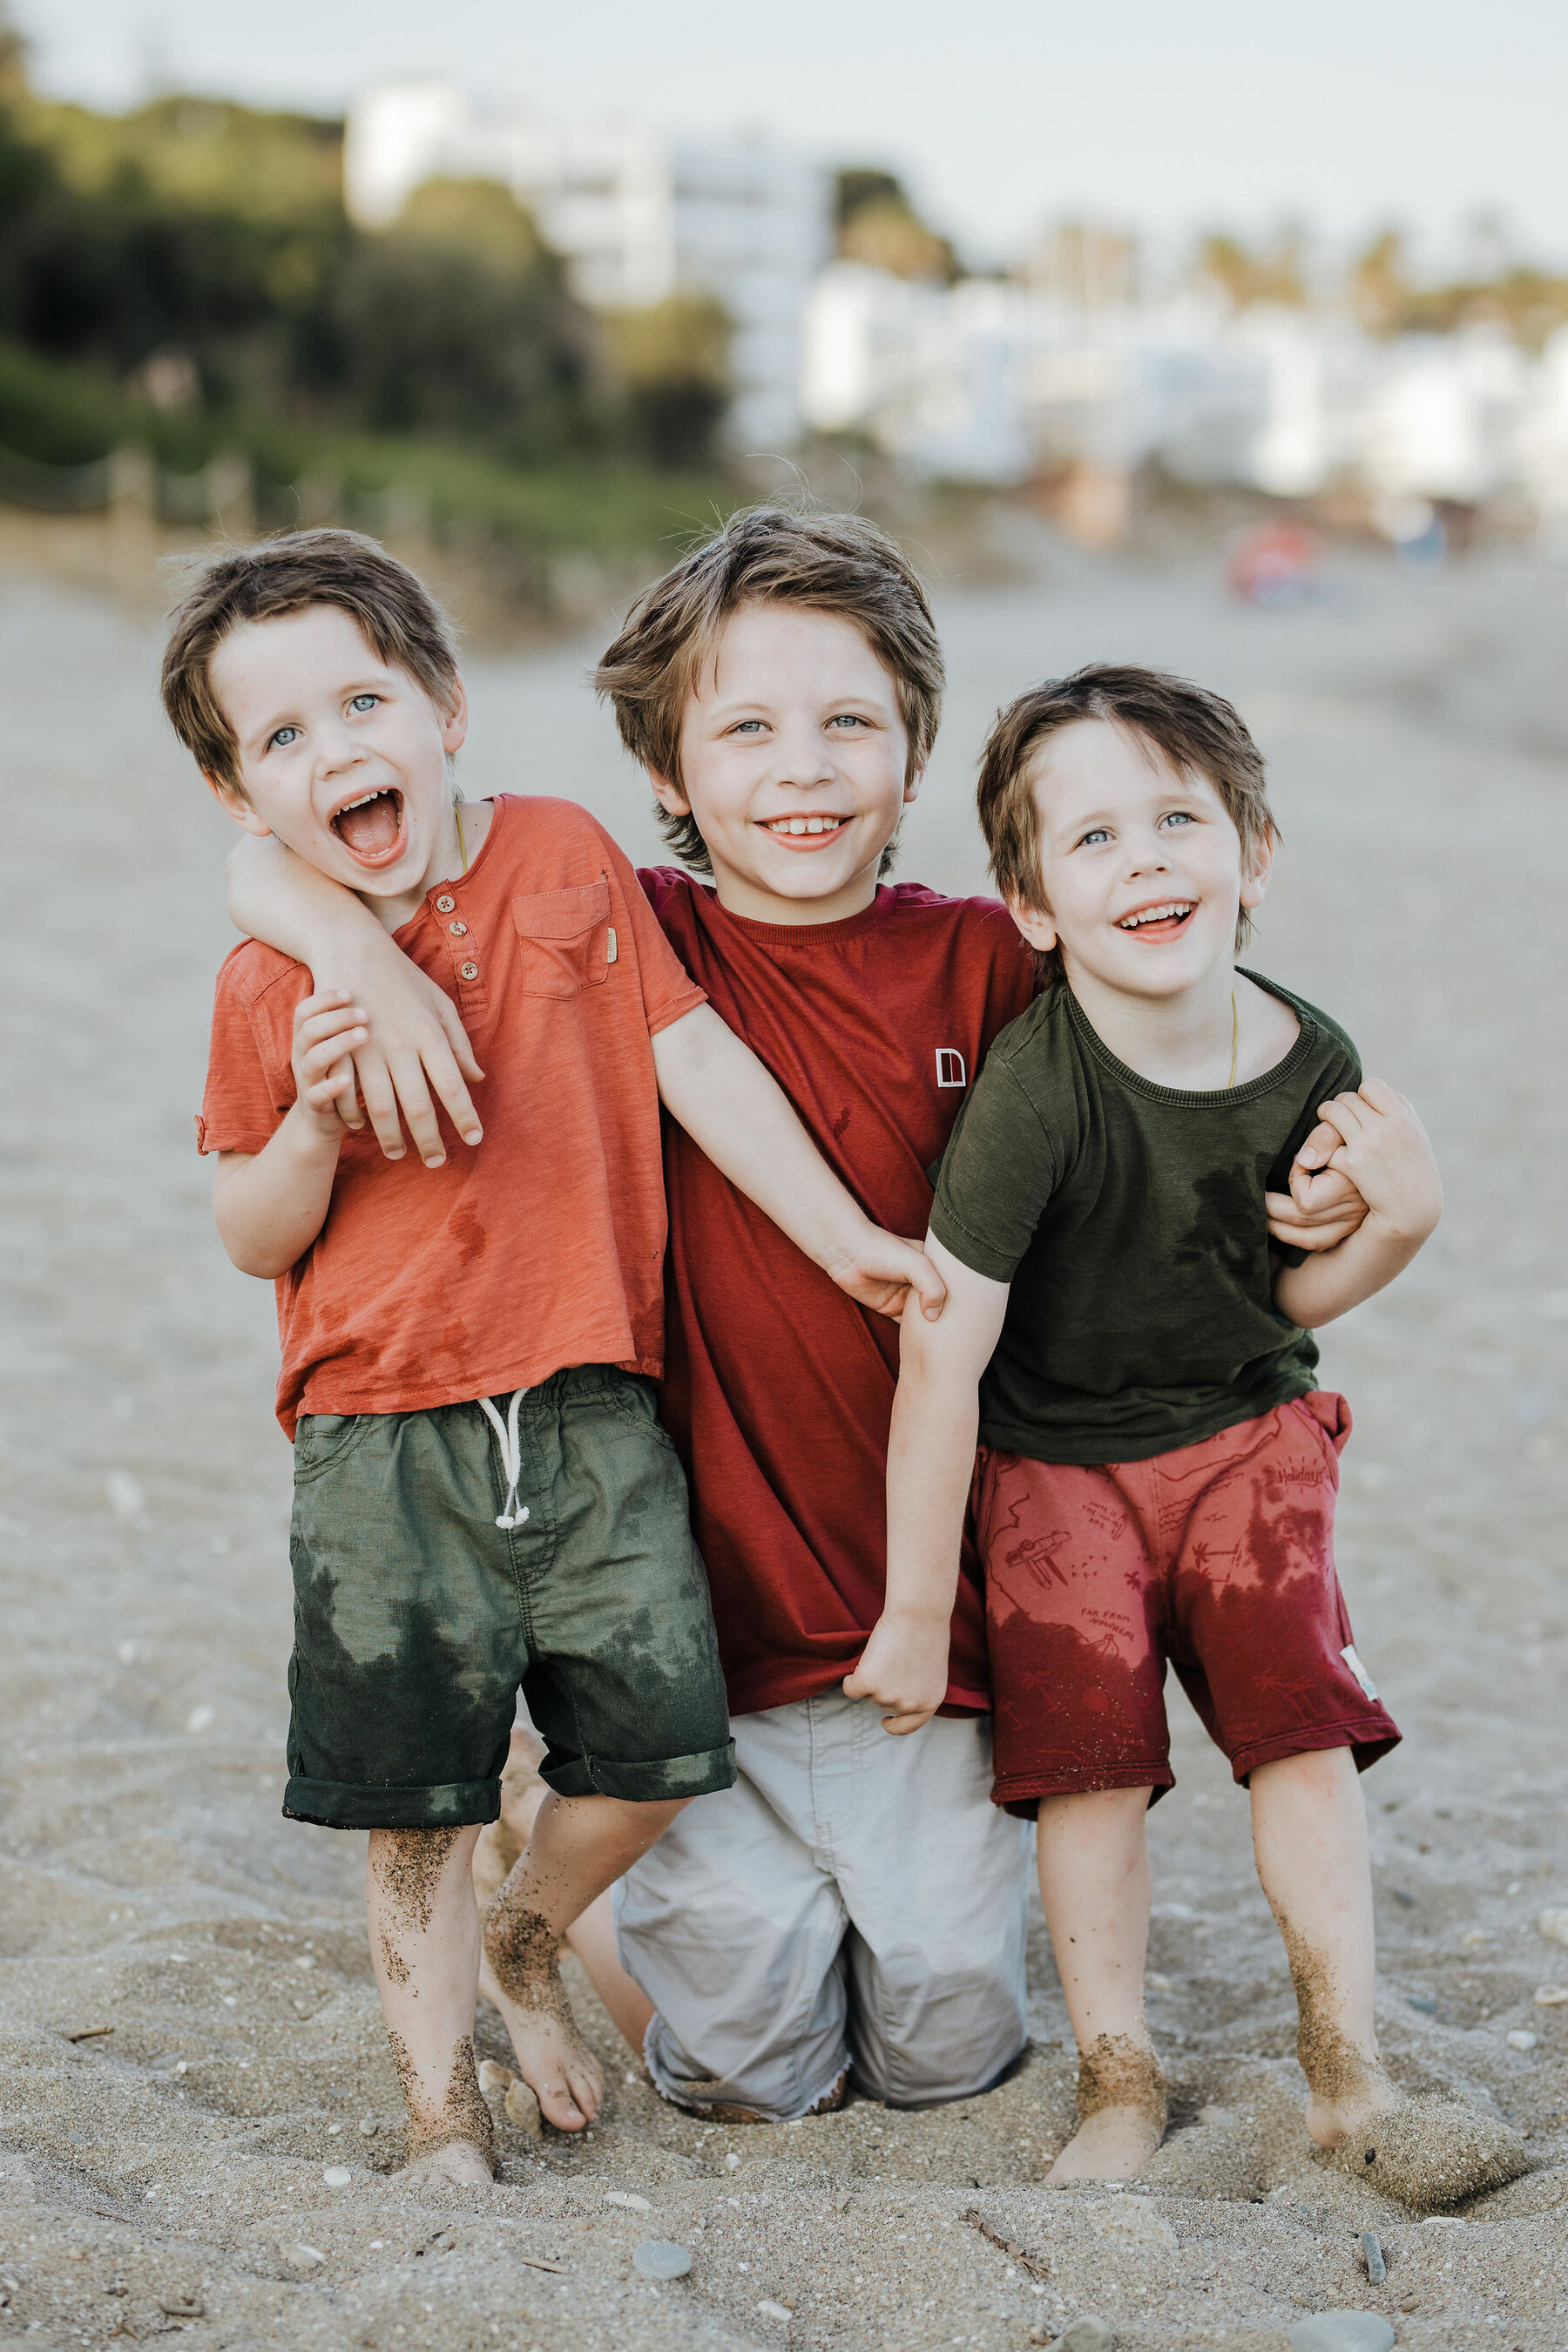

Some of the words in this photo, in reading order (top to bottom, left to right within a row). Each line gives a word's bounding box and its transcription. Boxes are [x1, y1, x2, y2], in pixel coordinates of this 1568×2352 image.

[1278, 1466, 1323, 1487] Holidays
[1081, 1608, 1098, 1617] FAR
[1103, 1611, 1130, 1622] FROM
[1089, 1618, 1135, 1642] NOWHERE
